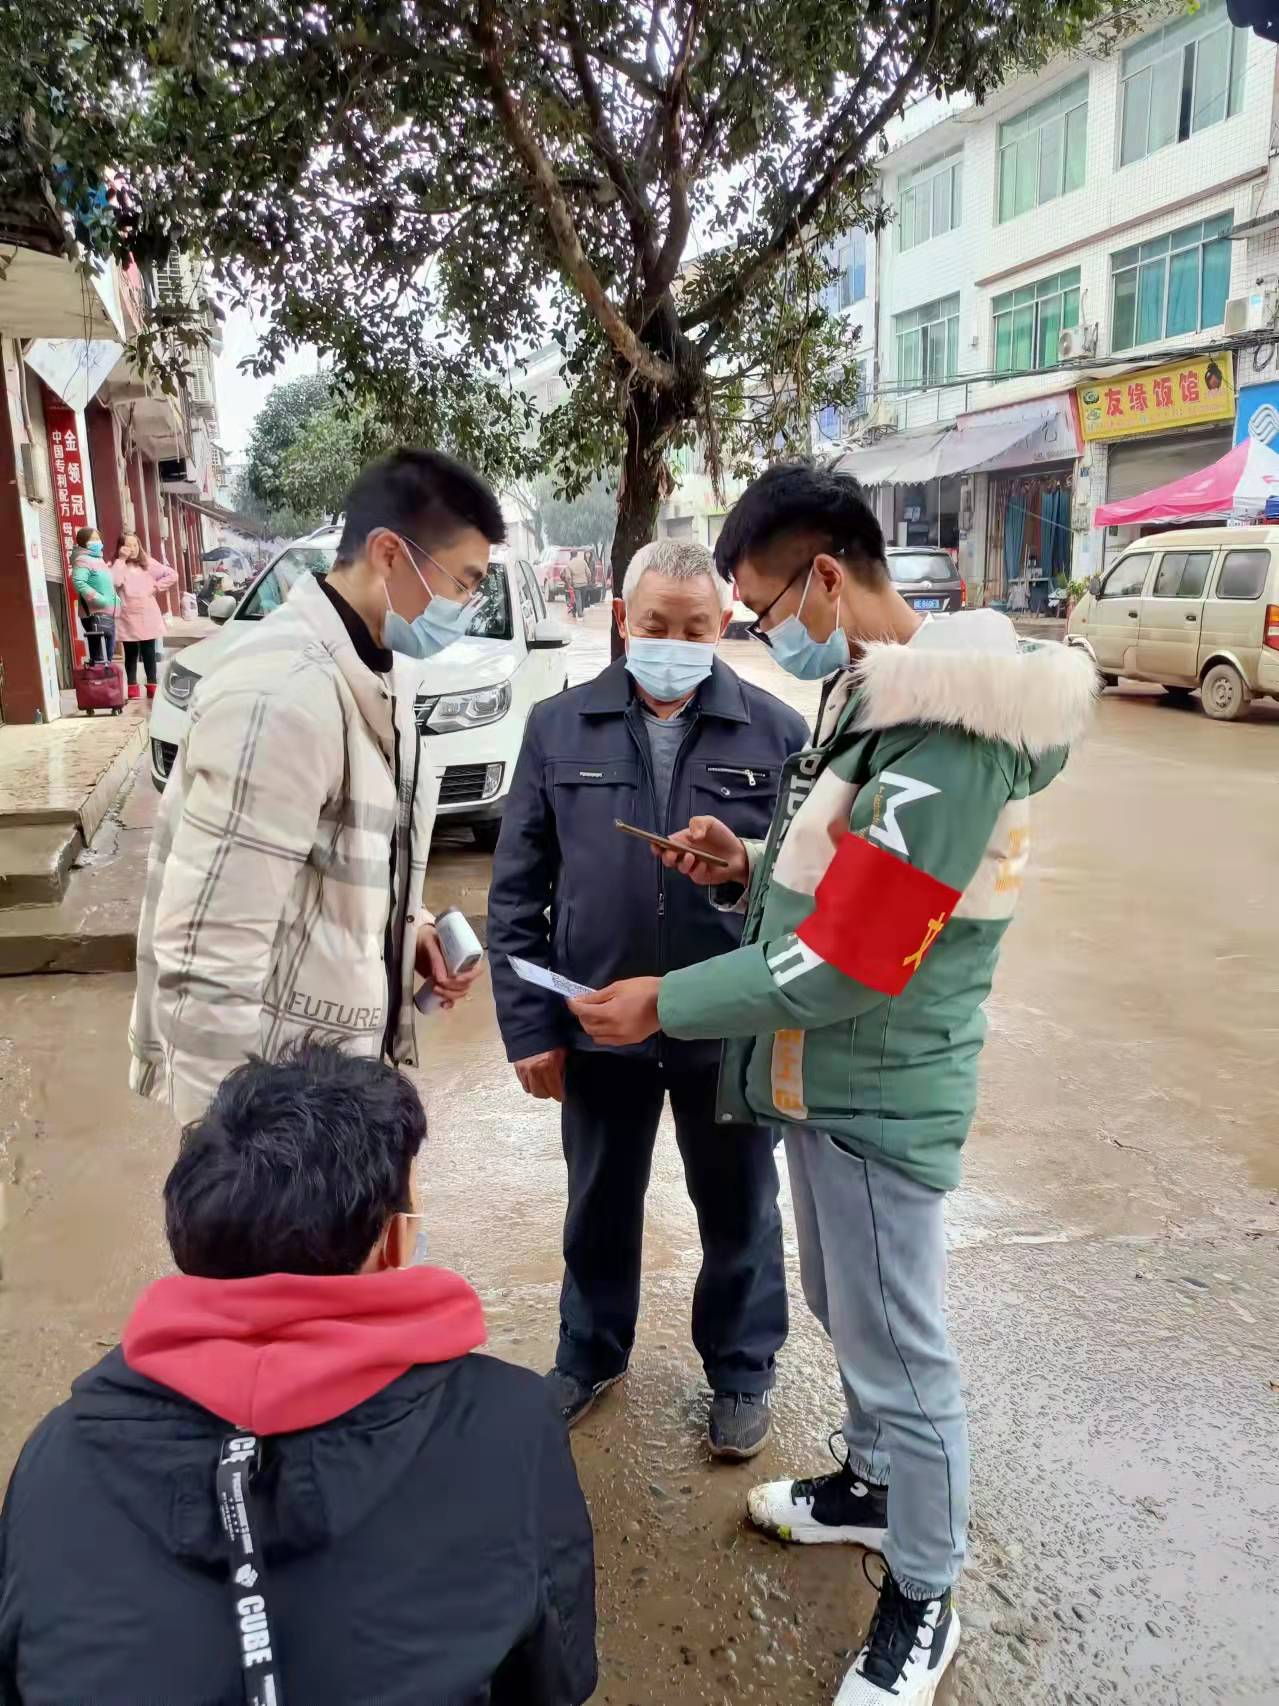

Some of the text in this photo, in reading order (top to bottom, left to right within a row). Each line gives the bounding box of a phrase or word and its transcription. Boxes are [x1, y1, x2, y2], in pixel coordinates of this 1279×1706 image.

[1104, 370, 1200, 416] 友缘饭馆
[52, 430, 70, 517] 中国专利配方
[64, 430, 87, 535] 金领冠
[288, 990, 381, 1027] FUTURE
[236, 1595, 273, 1668] CUBE
